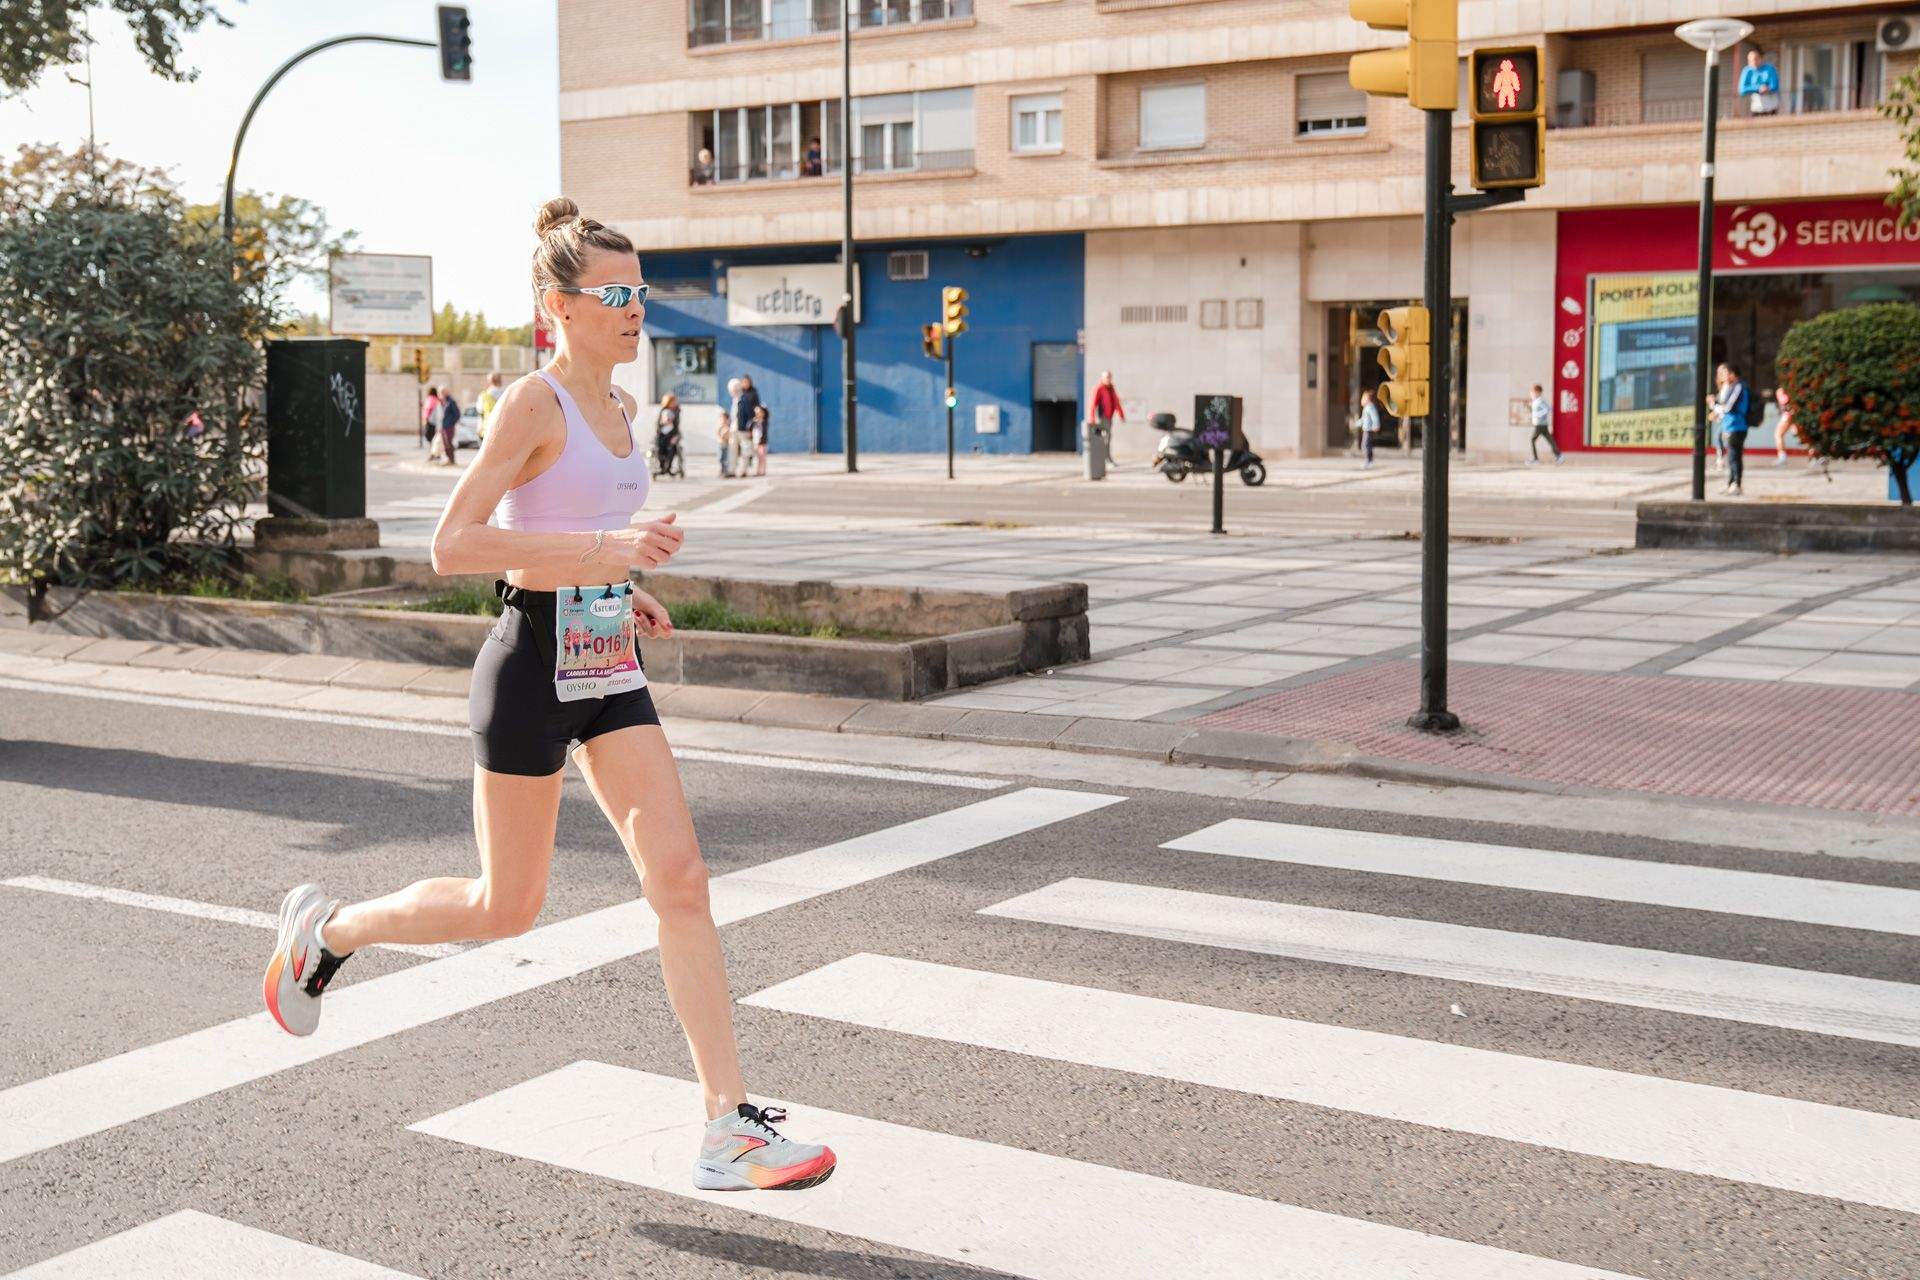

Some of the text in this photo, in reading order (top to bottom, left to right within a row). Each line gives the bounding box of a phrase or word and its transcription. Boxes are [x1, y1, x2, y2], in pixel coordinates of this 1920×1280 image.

[1600, 281, 1699, 304] PORTAFOLI
[593, 634, 621, 655] 016
[566, 681, 597, 692] OYSHO
